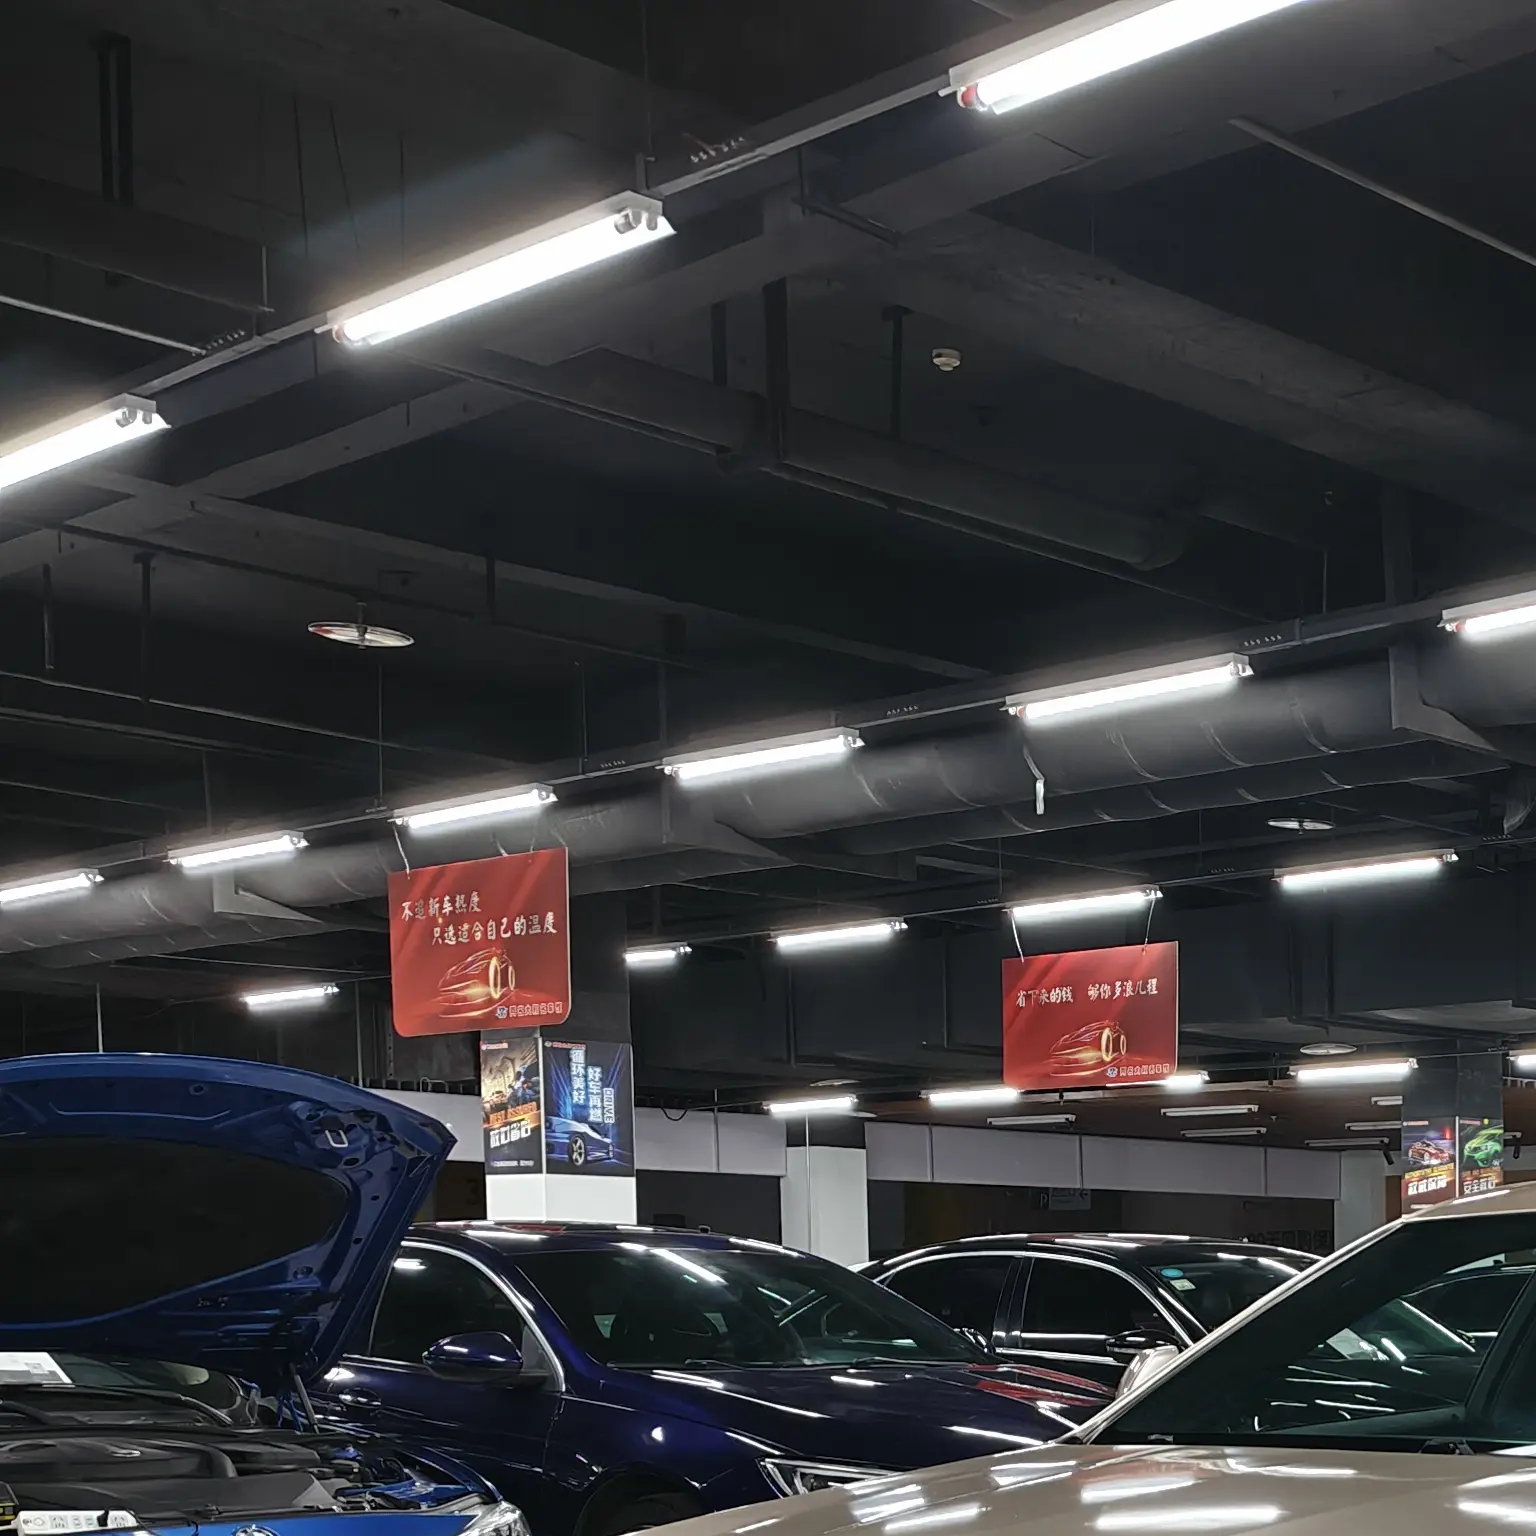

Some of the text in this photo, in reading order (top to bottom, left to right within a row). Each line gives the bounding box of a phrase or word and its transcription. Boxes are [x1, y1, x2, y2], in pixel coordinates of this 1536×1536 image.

[1016, 986, 1074, 1008] 省下来的钱
[603, 1087, 615, 1124] DRIVE
